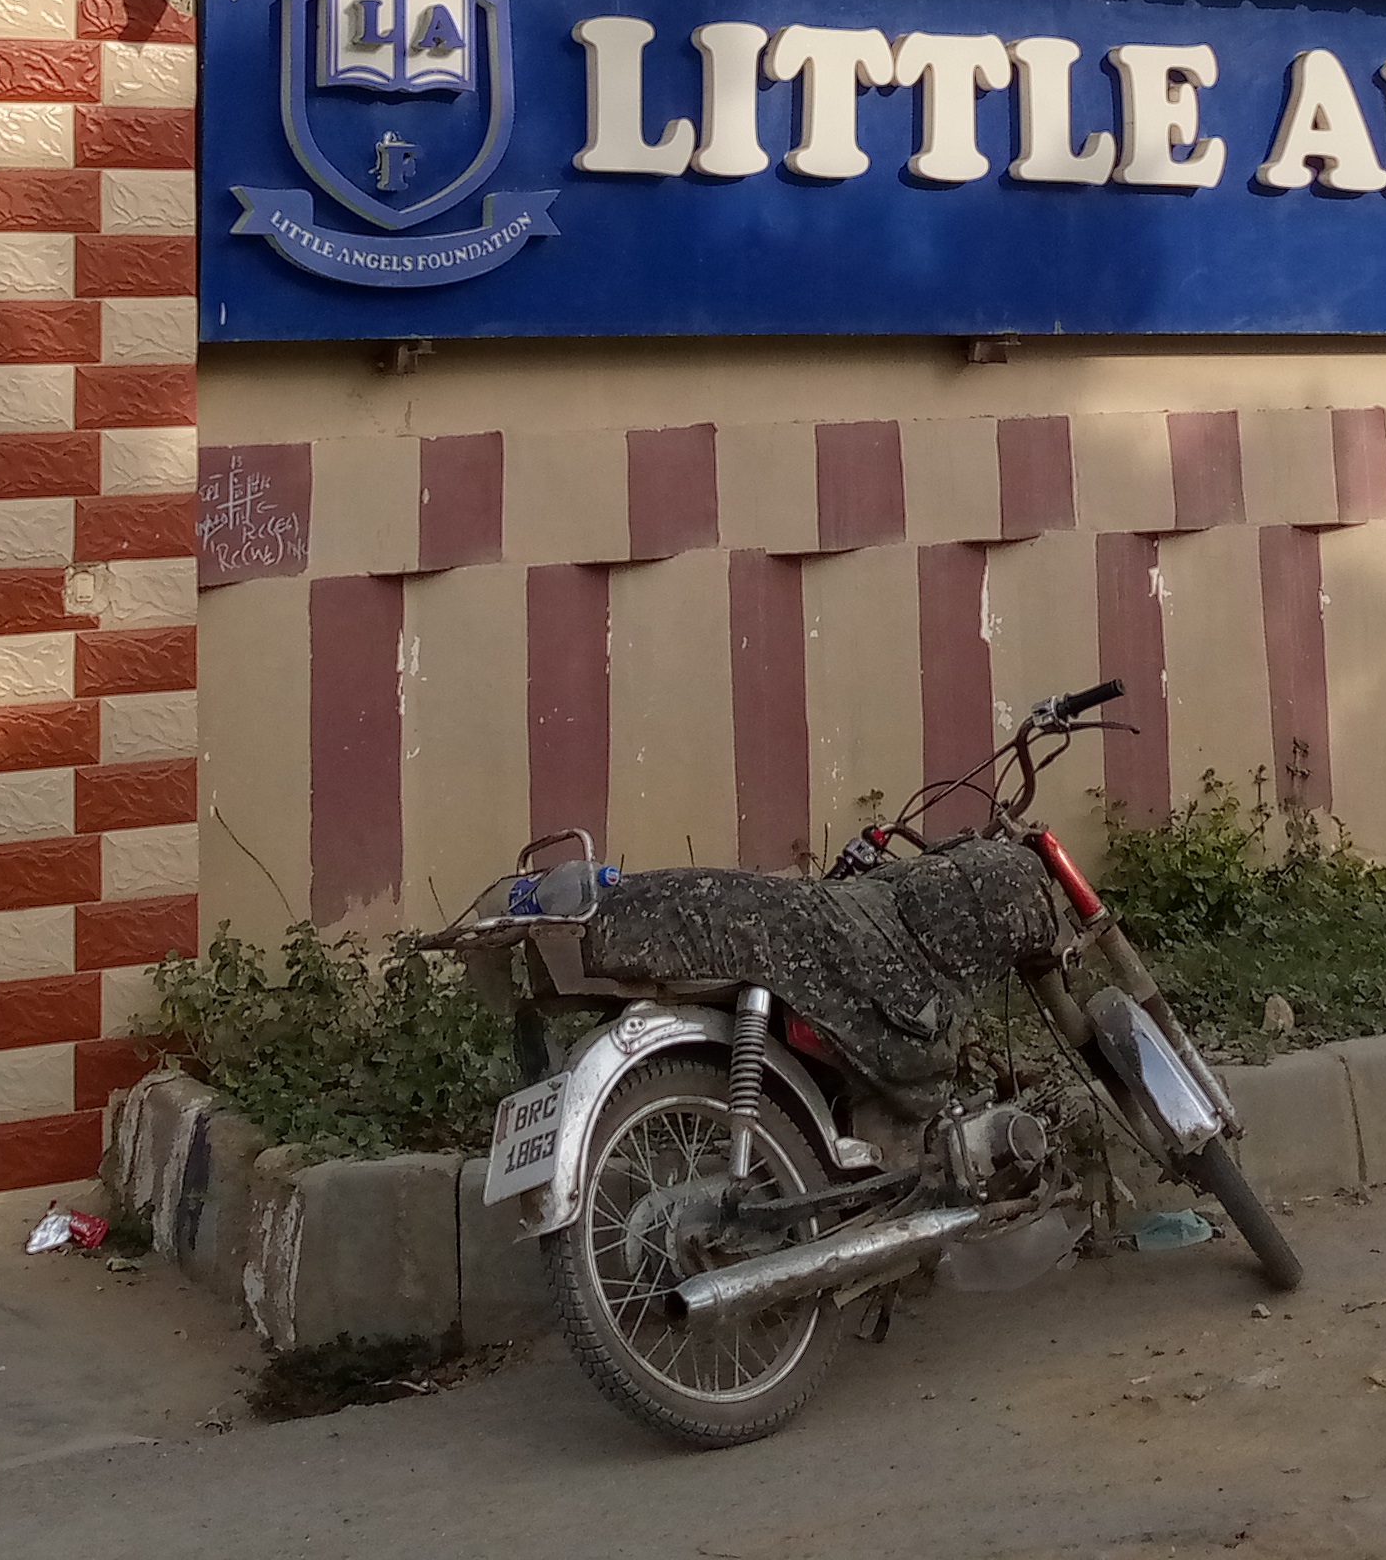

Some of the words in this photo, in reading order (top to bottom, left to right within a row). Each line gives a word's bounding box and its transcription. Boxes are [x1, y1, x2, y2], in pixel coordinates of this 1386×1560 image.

[349, 0, 393, 46] L
[416, 4, 465, 49] A
[572, 15, 1226, 187] LITTLE
[270, 209, 334, 257] LITTLE
[336, 247, 414, 272] ANGELS
[416, 211, 532, 272] FOUNDATION
[514, 1093, 559, 1132] BRC
[504, 1129, 558, 1175] 1863
